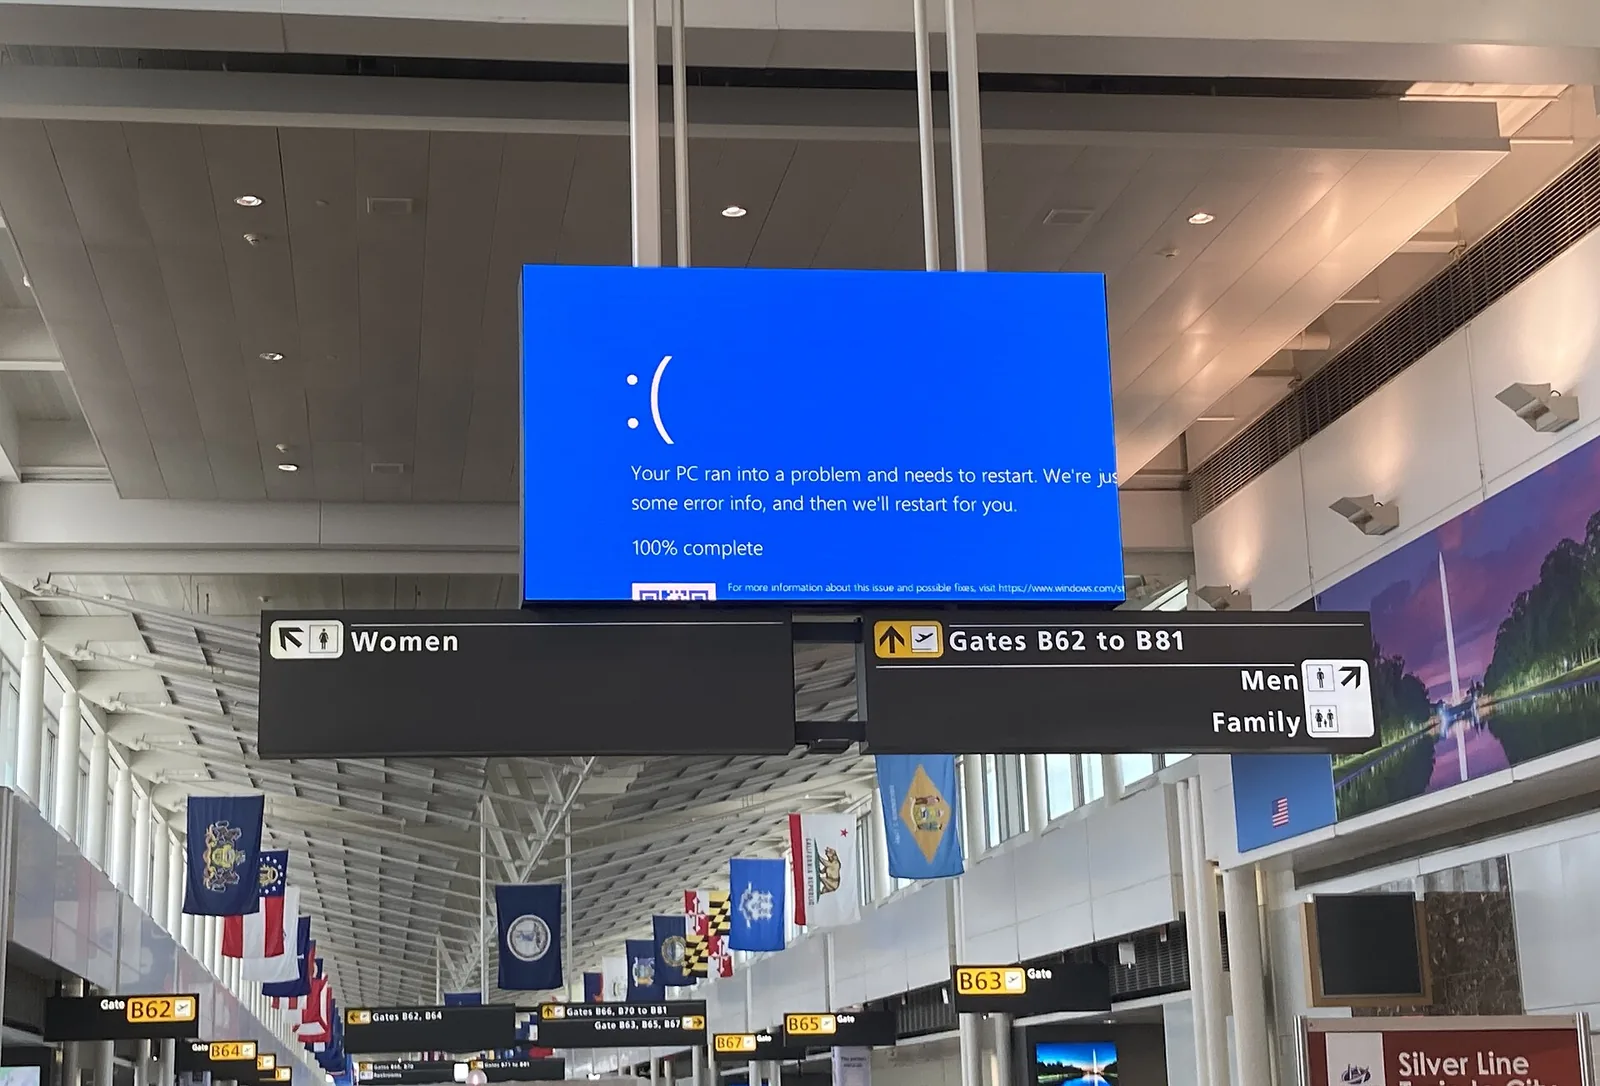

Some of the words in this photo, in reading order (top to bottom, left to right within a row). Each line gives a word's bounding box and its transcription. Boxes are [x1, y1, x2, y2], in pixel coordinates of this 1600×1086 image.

[631, 465, 671, 482] Your
[677, 465, 699, 482] PC
[705, 469, 731, 483] ran
[737, 466, 770, 483] into
[775, 470, 786, 483] a
[791, 466, 861, 487] problem
[867, 466, 898, 484] and
[904, 466, 954, 484] needs
[958, 468, 976, 484] to
[982, 468, 1038, 485] restart.
[1043, 468, 1092, 485] We're
[631, 498, 678, 512] some
[683, 498, 725, 512] error
[730, 494, 766, 515] info,
[772, 495, 804, 512] and
[809, 495, 847, 512] then
[852, 495, 889, 512] we'll
[895, 497, 948, 513] restart
[952, 495, 978, 513] for
[981, 499, 1017, 518] you.
[632, 539, 678, 557] 100%
[683, 539, 764, 561] complete
[727, 582, 743, 593] For
[745, 584, 770, 593] more
[771, 582, 823, 593] information
[826, 582, 851, 593] about
[853, 583, 870, 593] this
[872, 584, 895, 593] issue
[896, 583, 915, 593] and
[916, 583, 952, 595] possible
[954, 582, 977, 594] fixes,
[979, 583, 996, 593] visit
[351, 631, 459, 653] Women
[949, 629, 1027, 653] Gates
[1037, 629, 1087, 652] B62
[1096, 631, 1125, 652] to
[1136, 629, 1184, 652] B81
[1241, 669, 1299, 691] Men
[1211, 710, 1301, 738] Family
[960, 971, 1002, 990] B63
[1027, 967, 1052, 980] Gate
[100, 998, 126, 1011] Gate
[131, 1000, 172, 1018] B62
[372, 1011, 400, 1022] Gates
[402, 1011, 422, 1022] B62,
[425, 1010, 443, 1021] B64
[565, 1007, 593, 1017] Gates
[637, 1006, 648, 1016] to
[594, 1020, 617, 1031] Gate
[664, 1019, 681, 1029] B67
[788, 1016, 820, 1031] B65
[836, 1014, 856, 1024] Gate
[211, 1044, 241, 1058] B64
[717, 1036, 741, 1049] B67
[1398, 1051, 1469, 1077] Silver
[1477, 1050, 1530, 1076] Line
